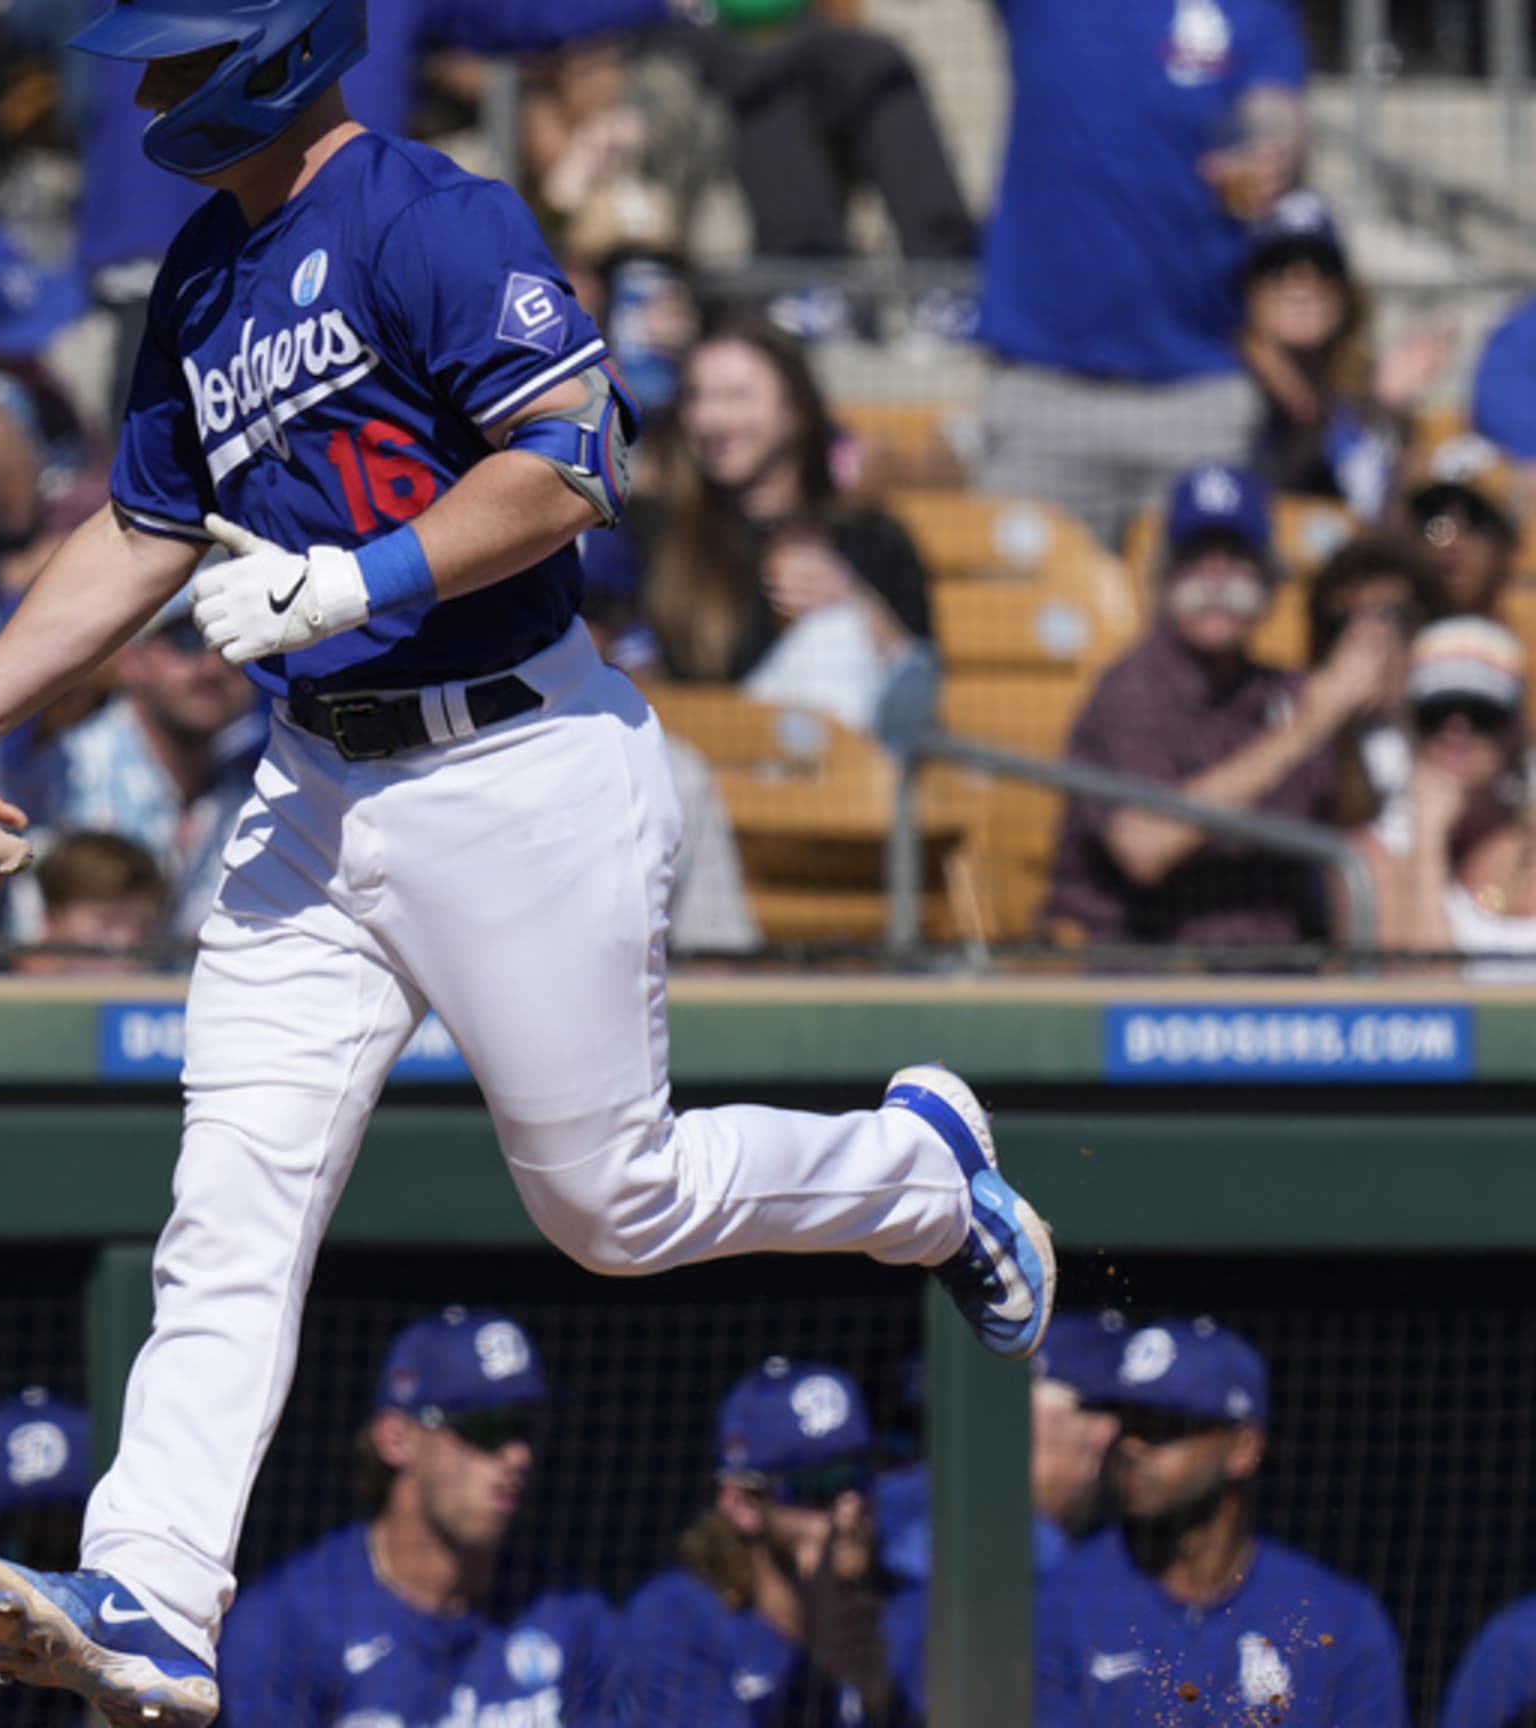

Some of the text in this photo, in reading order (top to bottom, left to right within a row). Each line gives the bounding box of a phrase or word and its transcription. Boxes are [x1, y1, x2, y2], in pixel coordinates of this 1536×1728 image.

[513, 286, 553, 327] G
[327, 418, 437, 534] 16
[1124, 1012, 1457, 1065] DODGERS.COM
